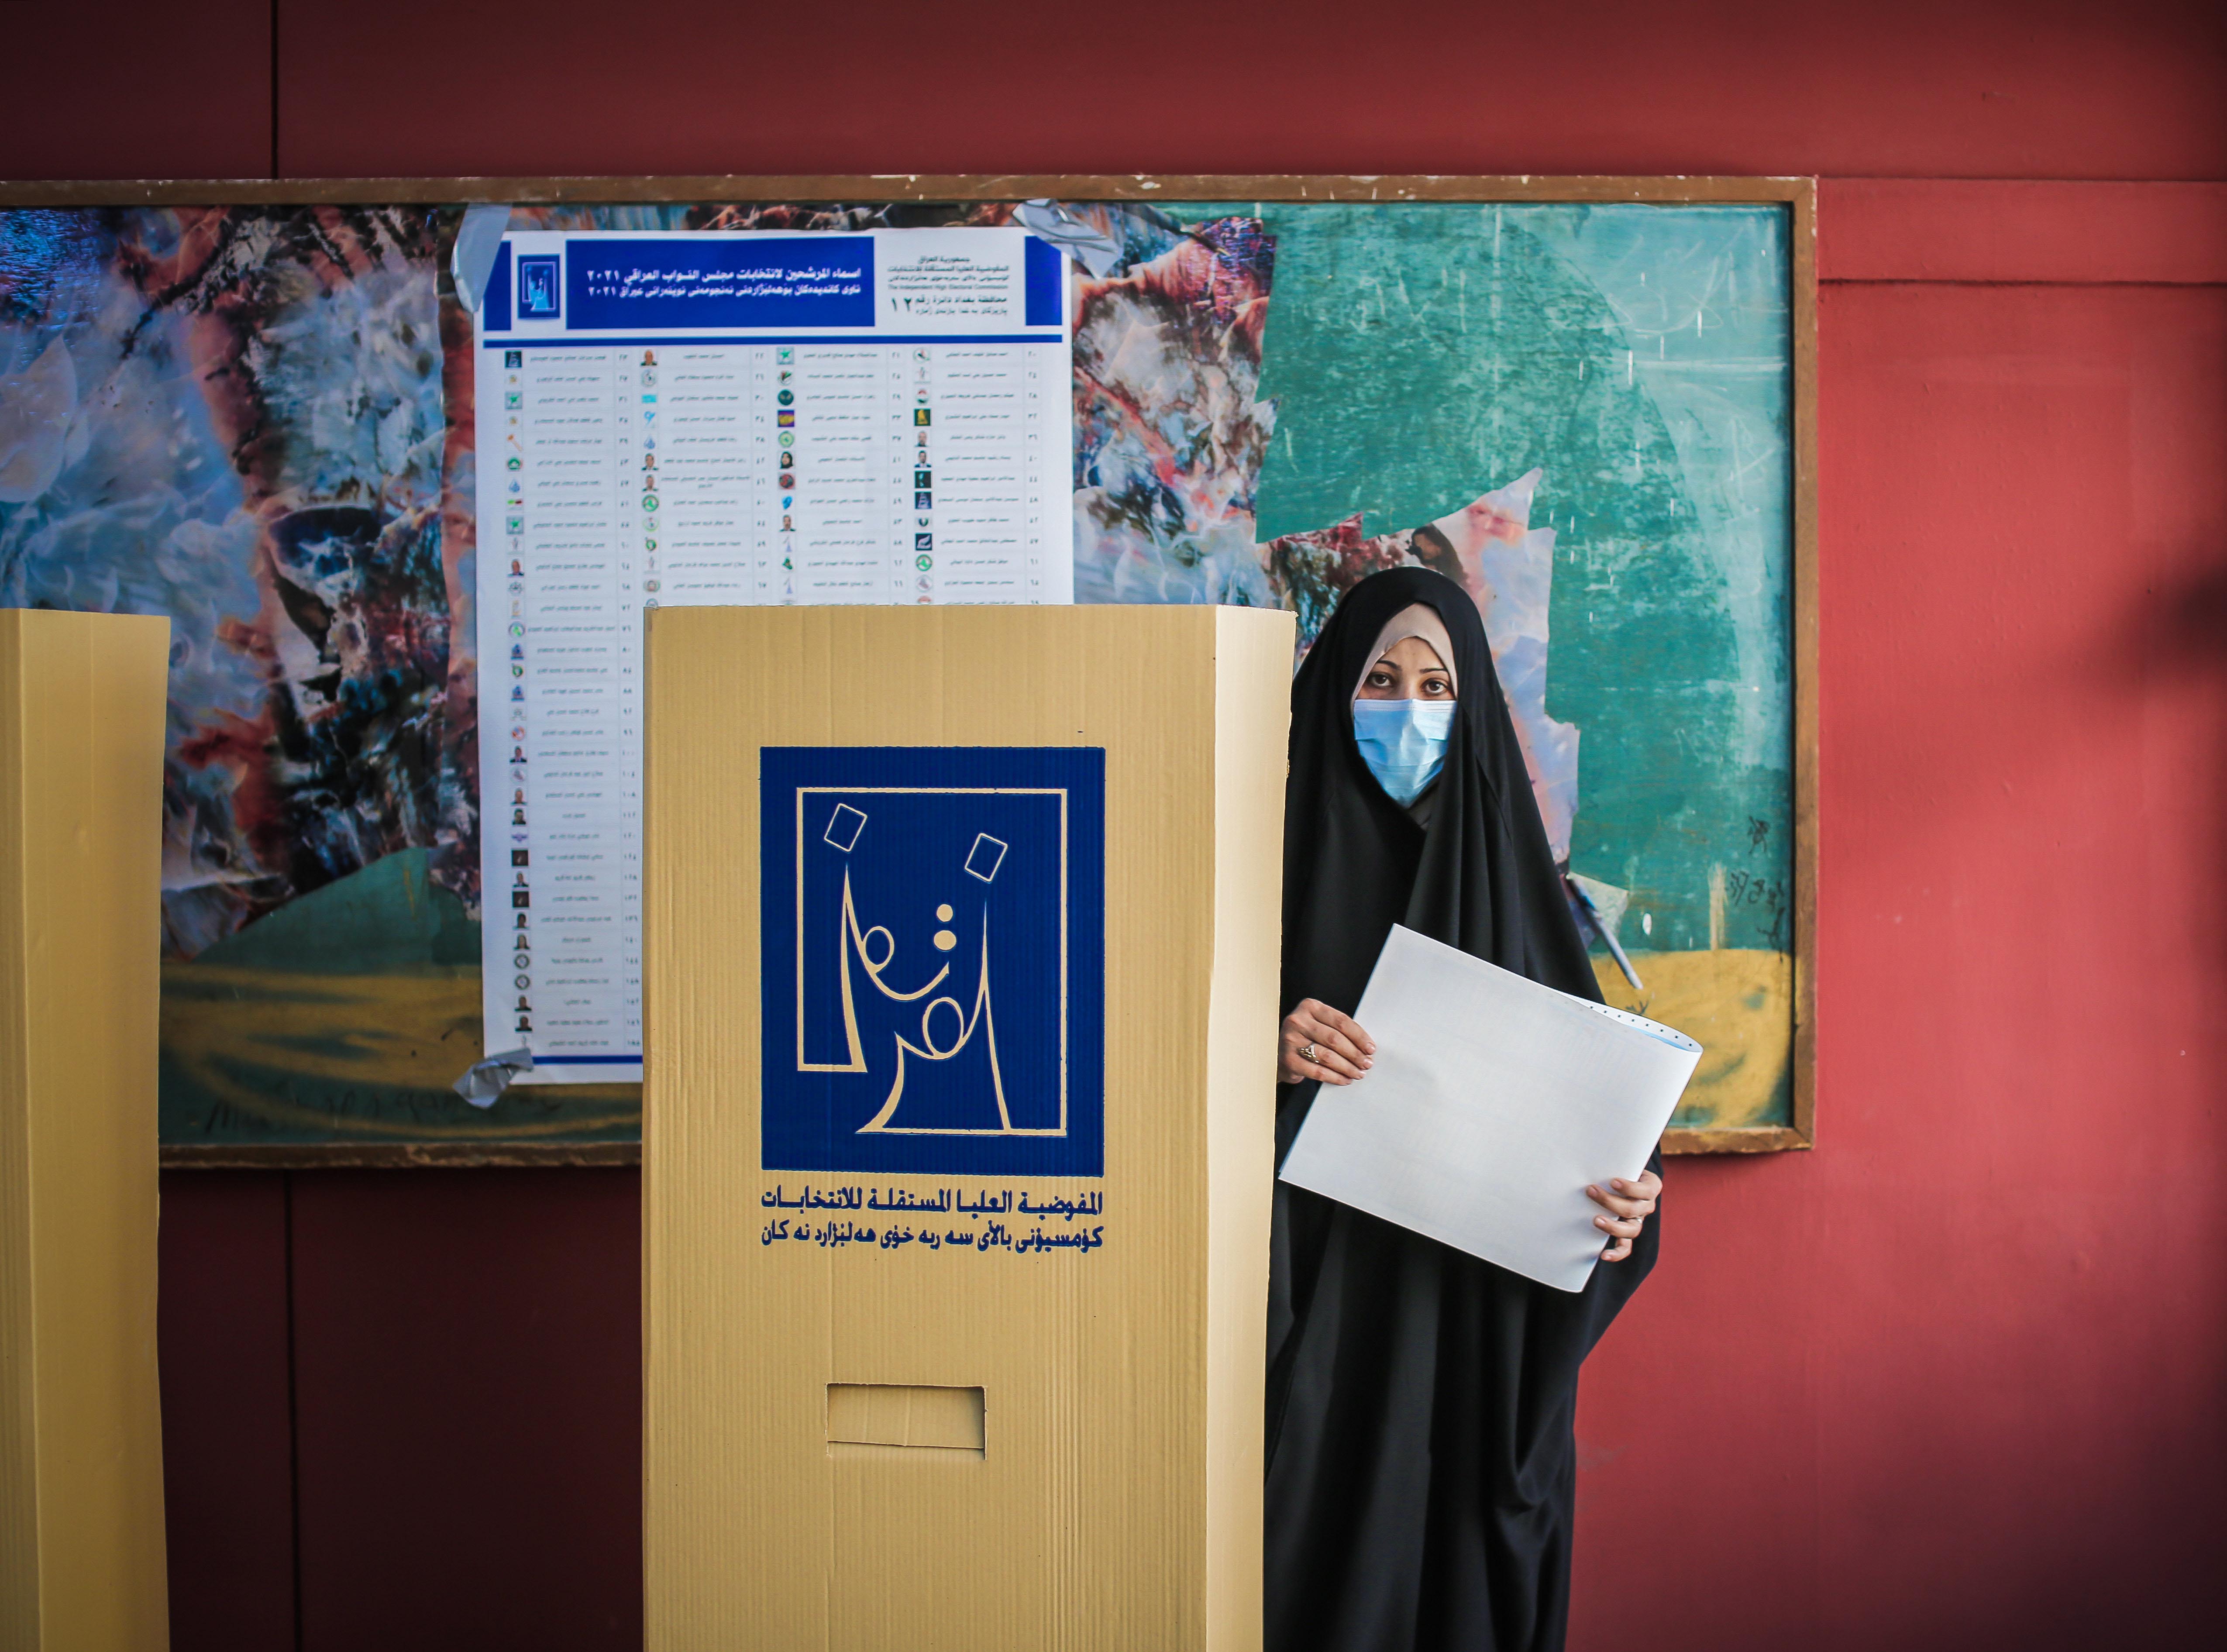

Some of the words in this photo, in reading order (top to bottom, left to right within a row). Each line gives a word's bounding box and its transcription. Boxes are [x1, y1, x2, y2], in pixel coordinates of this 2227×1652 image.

[587, 270, 620, 281] ٢٠٢١
[662, 270, 699, 281] النواب
[702, 271, 733, 282] مجلس
[786, 267, 830, 280] المرشحين
[588, 286, 616, 297] ٢٠٢١
[761, 1184, 863, 1215] للانتخابات
[867, 1187, 951, 1213] المستقلة
[956, 1188, 1012, 1220] العليا
[1018, 1190, 1103, 1222] المفوضية
